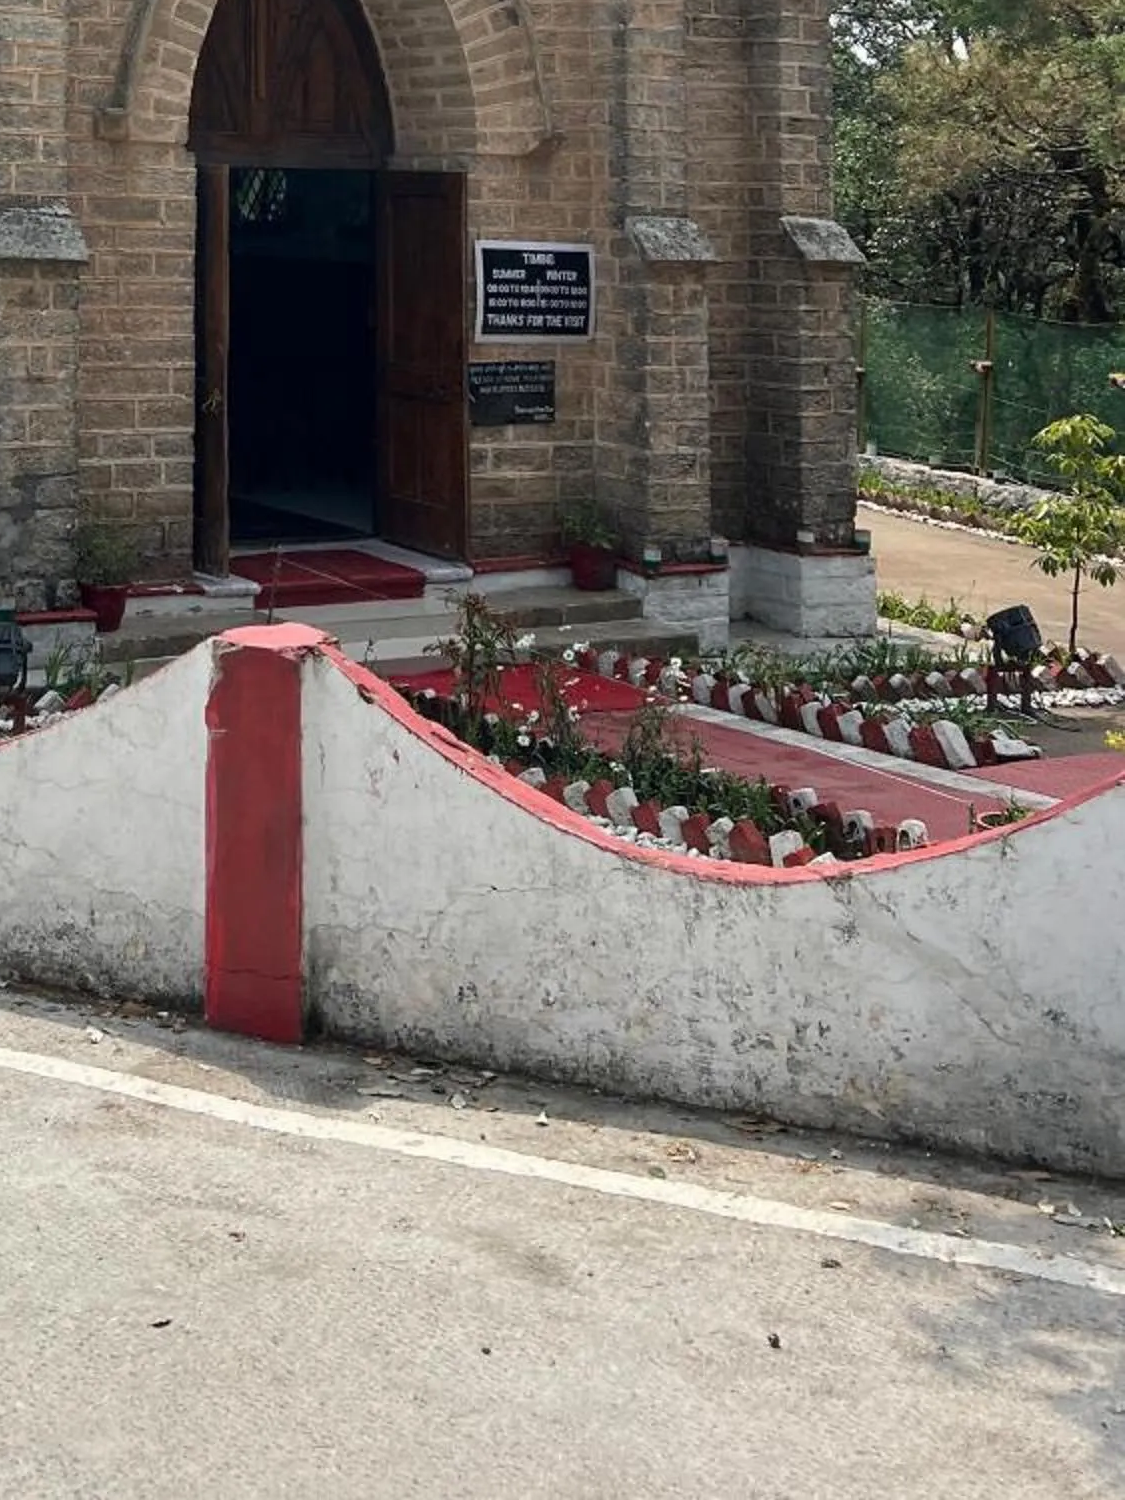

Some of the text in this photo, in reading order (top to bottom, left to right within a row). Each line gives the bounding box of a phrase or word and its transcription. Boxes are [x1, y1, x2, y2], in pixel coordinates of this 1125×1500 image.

[492, 268, 526, 279] SUMMER
[545, 270, 578, 281] WINTER
[486, 313, 586, 328] THANKS FOR THE VISIT
